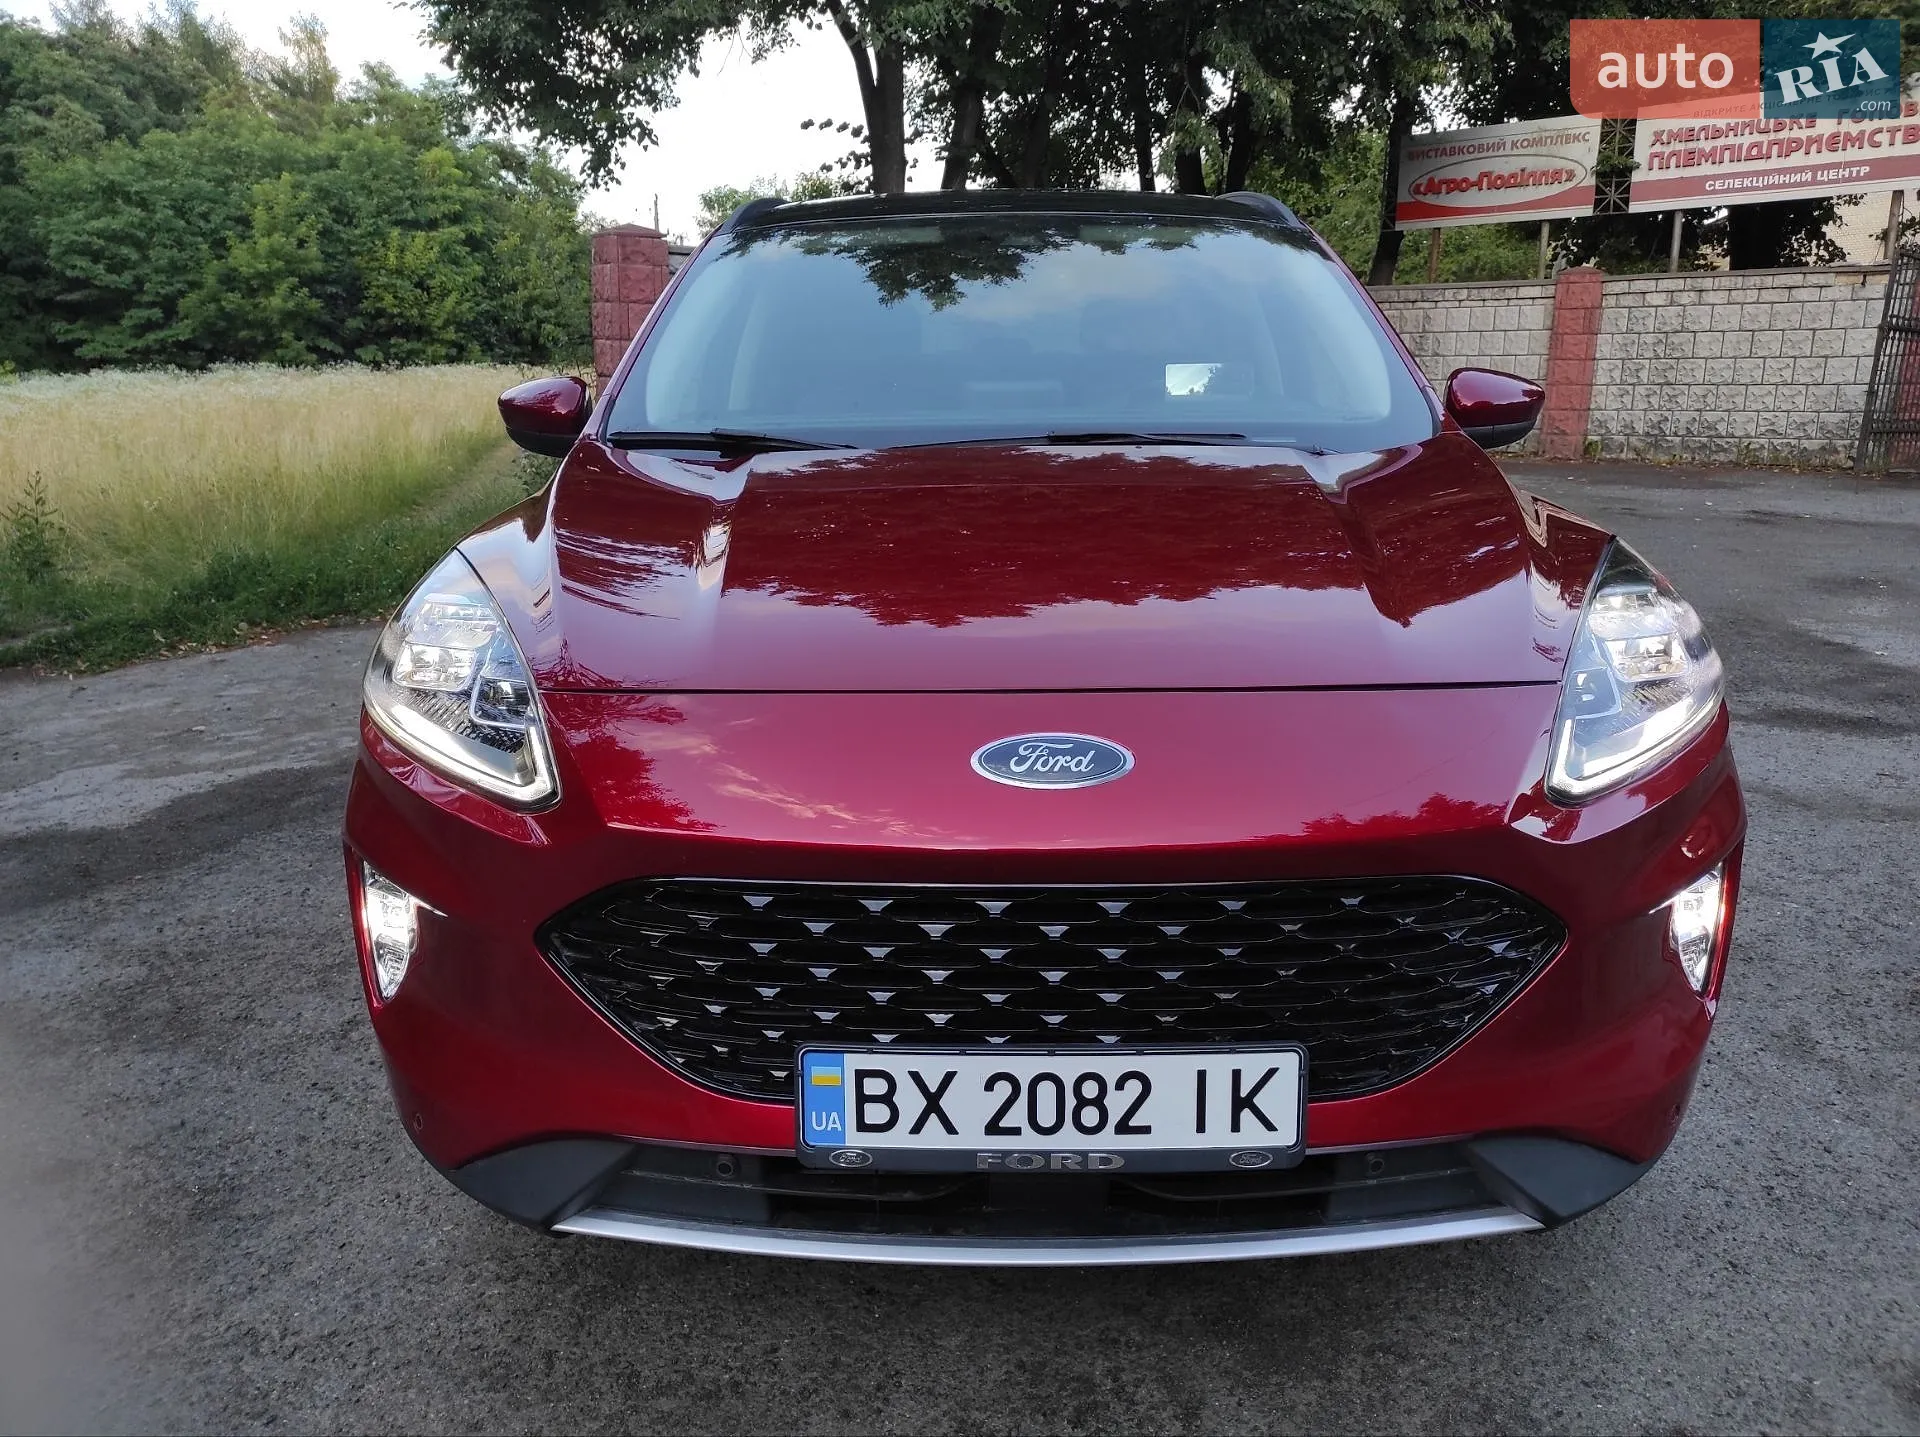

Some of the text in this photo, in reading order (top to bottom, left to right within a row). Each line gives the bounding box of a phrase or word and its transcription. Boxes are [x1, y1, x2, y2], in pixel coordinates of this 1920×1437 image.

[1705, 165, 1871, 192] СЕЛЕКЦІЙНИЙ ЦЕНТР
[1009, 741, 1096, 773] Ford
[854, 1068, 959, 1136] BX
[983, 1071, 1152, 1136] 2082
[811, 1111, 842, 1132] UA
[976, 1152, 1126, 1171] FORD
